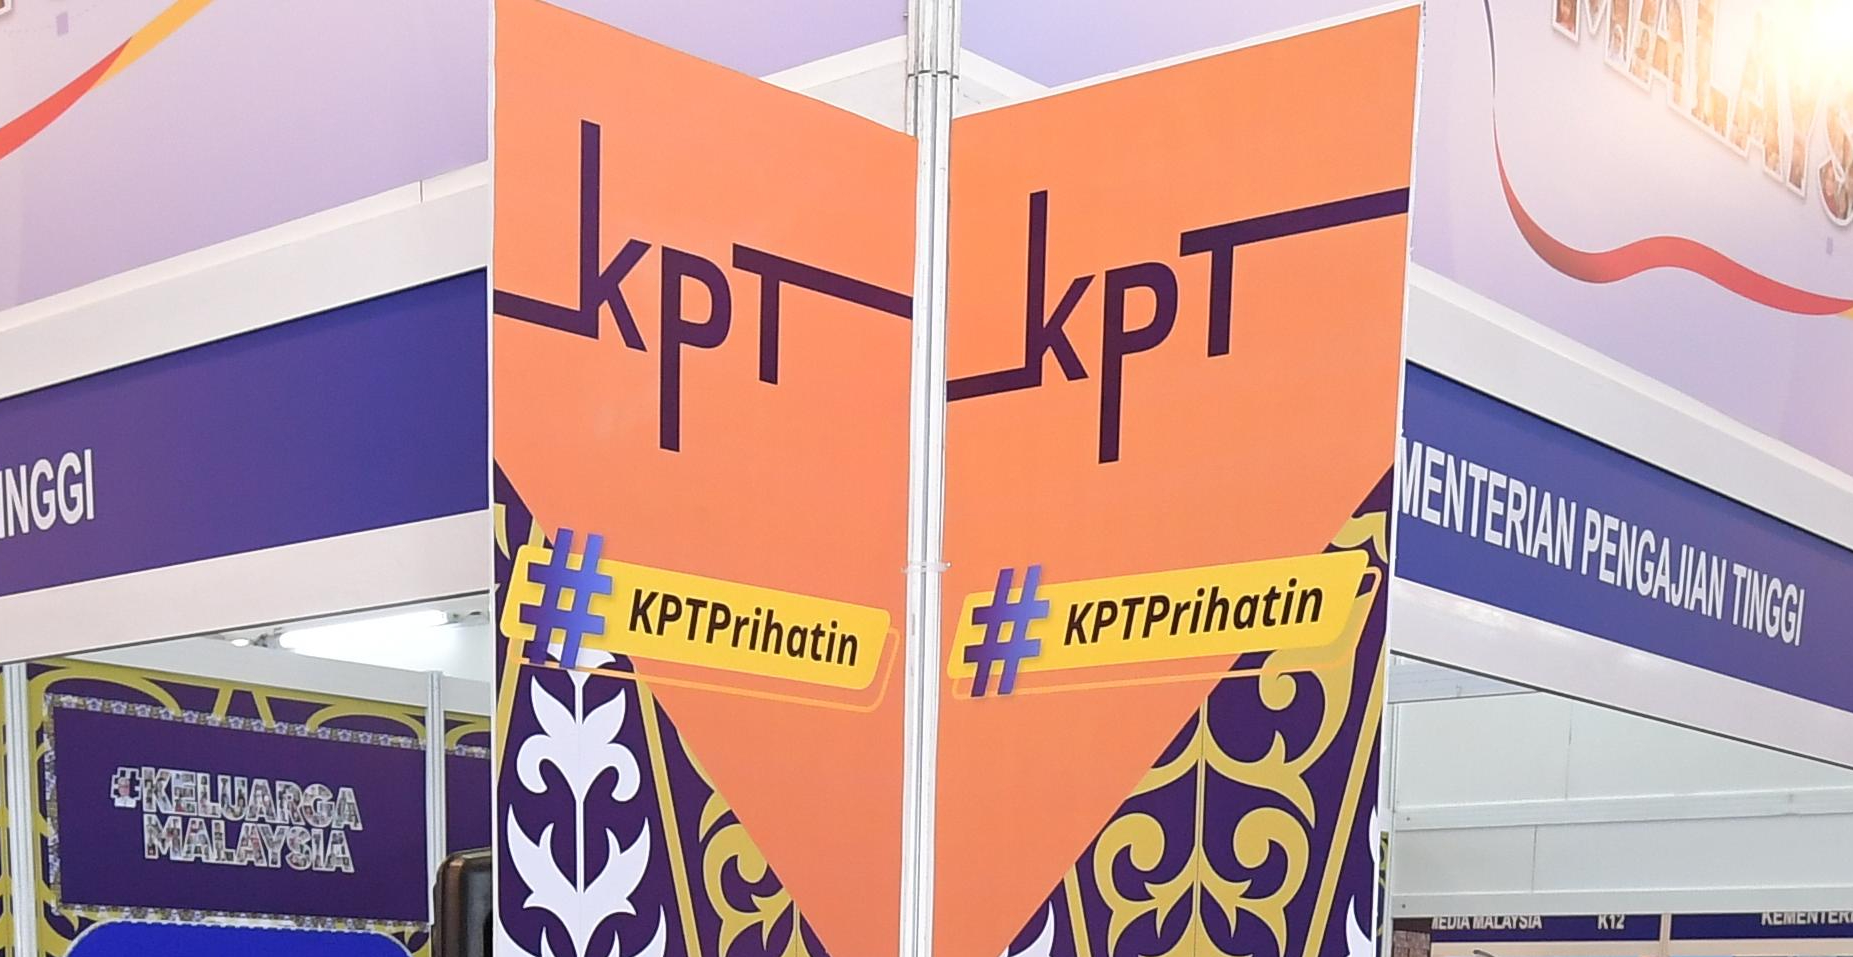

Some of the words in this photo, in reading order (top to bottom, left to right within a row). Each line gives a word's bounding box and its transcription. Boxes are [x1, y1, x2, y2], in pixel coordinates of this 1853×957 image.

[1399, 438, 1577, 571] MENTERIAN
[1581, 507, 1727, 620] PENGAJIAN
[1732, 562, 1806, 646] TINGGI
[111, 767, 364, 832] #KELUARGA
[144, 815, 355, 873] MALAYSIA
[1473, 915, 1543, 930] MALAYSIA
[1598, 914, 1625, 930] K12
